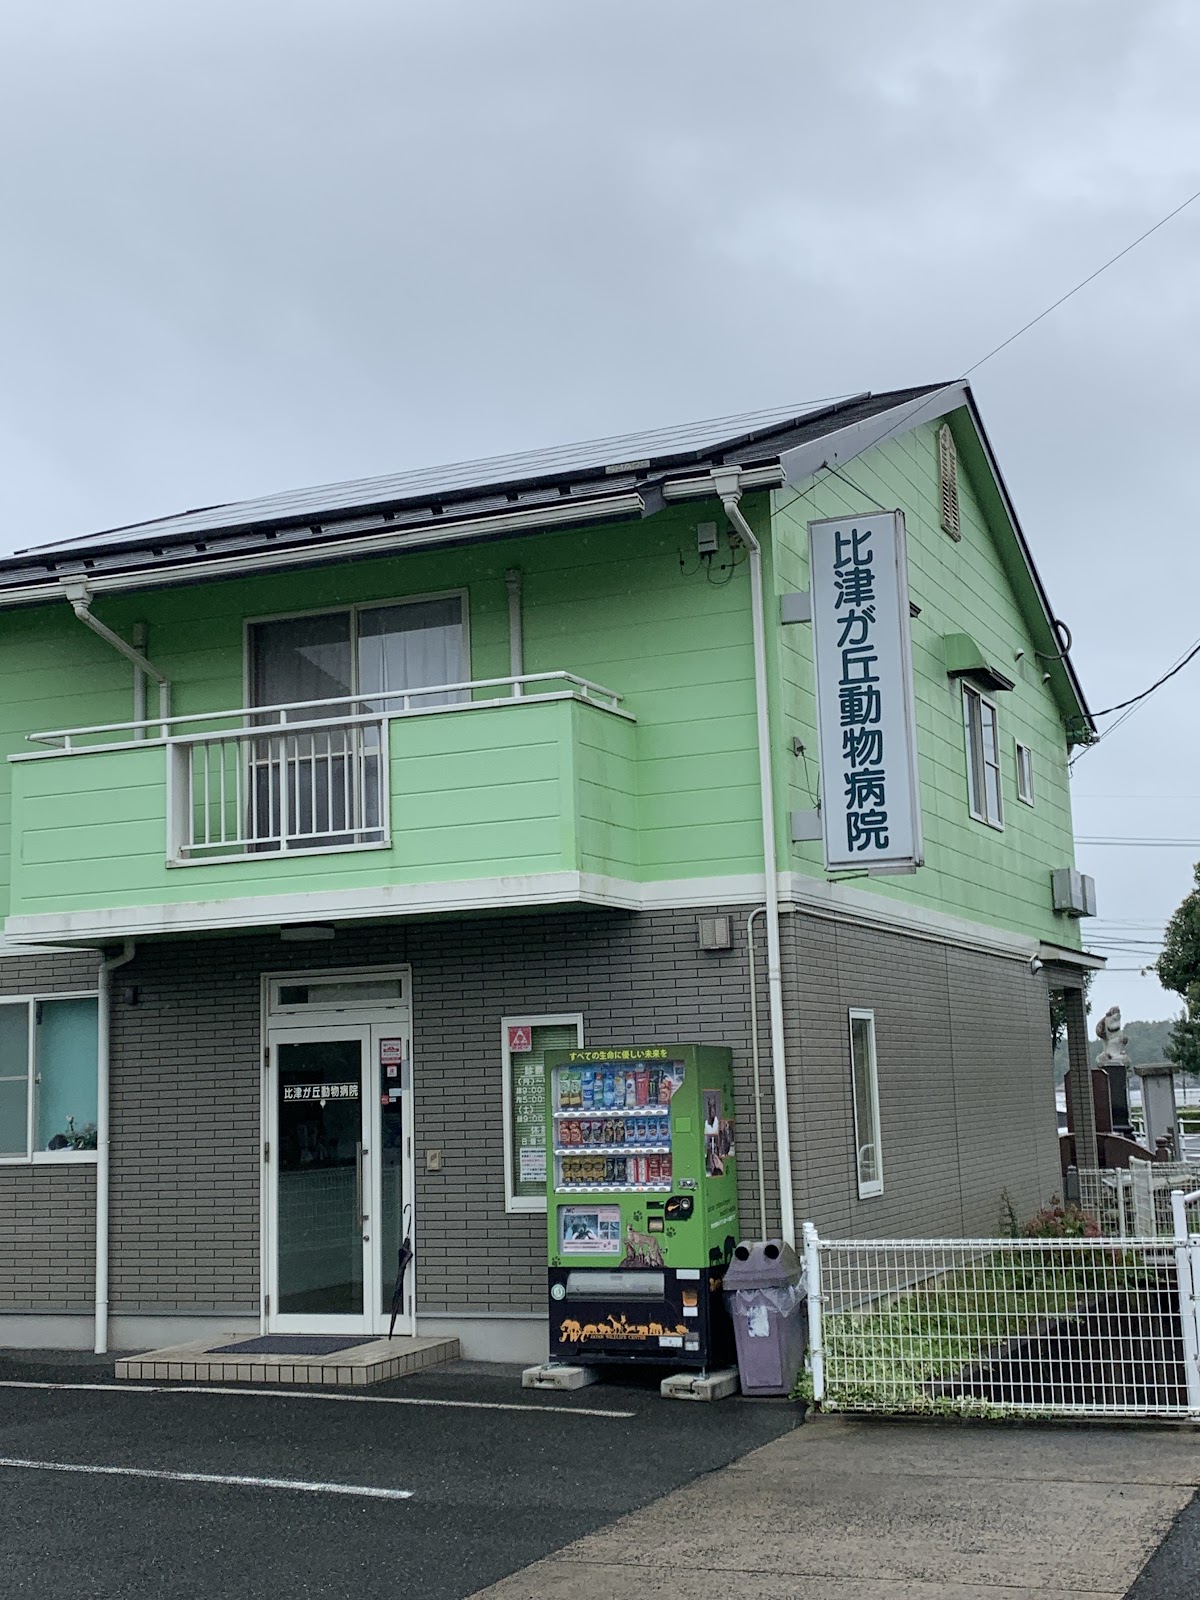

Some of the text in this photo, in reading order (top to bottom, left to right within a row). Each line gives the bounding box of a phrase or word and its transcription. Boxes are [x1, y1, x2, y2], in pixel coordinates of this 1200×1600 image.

[833, 528, 889, 853] 比津が丘動物病院
[569, 1048, 668, 1061] すべての生命に優しい未来を
[284, 1084, 359, 1099] 比津が丘動物病院
[559, 1331, 588, 1343] JWC
